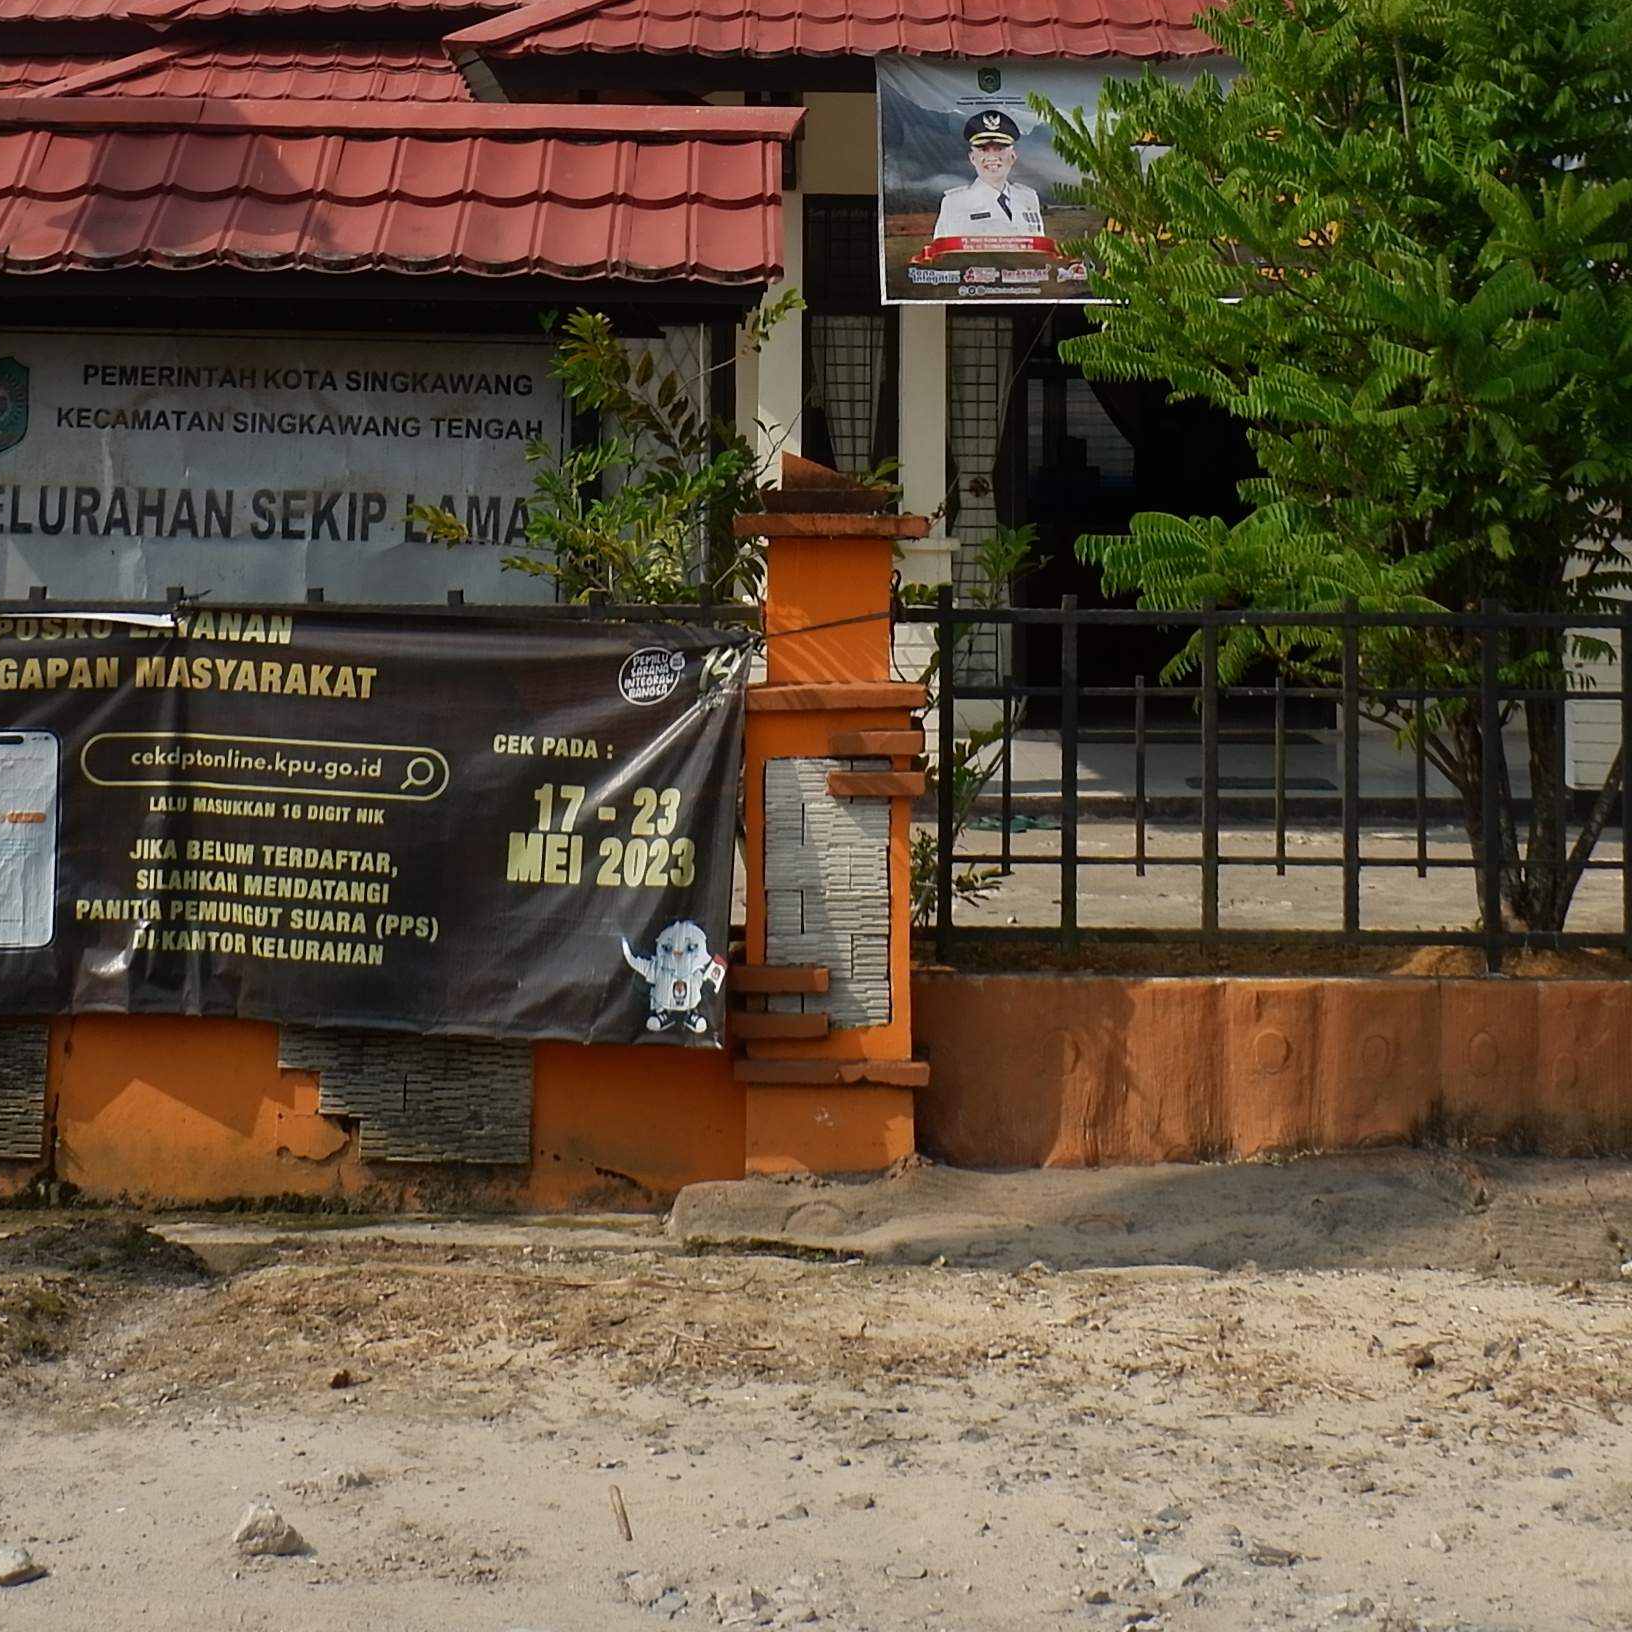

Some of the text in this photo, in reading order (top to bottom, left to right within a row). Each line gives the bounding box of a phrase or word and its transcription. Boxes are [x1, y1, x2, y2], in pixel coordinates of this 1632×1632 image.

[83, 364, 533, 396] PEMERINTAH KOTA SINGKAWANG
[56, 407, 543, 441] KECAMATAN SINGKAWANG TENGAH
[249, 488, 387, 542] SEKIP
[134, 656, 377, 699] MASYARAKAT
[630, 663, 670, 677] SARANA
[632, 653, 669, 666] PEMILU
[131, 746, 383, 779] cekdptonline.kpu.go.id
[493, 733, 535, 756] CEK
[542, 736, 599, 759] PADA
[149, 796, 386, 825] LALU MASUKKAN 16 DIGIT NIK
[534, 783, 586, 833] 17
[631, 786, 682, 836] 23
[129, 838, 399, 879] JIKA BELUM TERDAFTAR,
[506, 831, 696, 888] MEI 2023
[135, 868, 390, 905] SILAHKAN MENDATANGI
[75, 898, 440, 944] PANITIA PEMUNGUT SUARA (PPS)
[131, 928, 385, 966] DI KANTOR KELURAHAN
